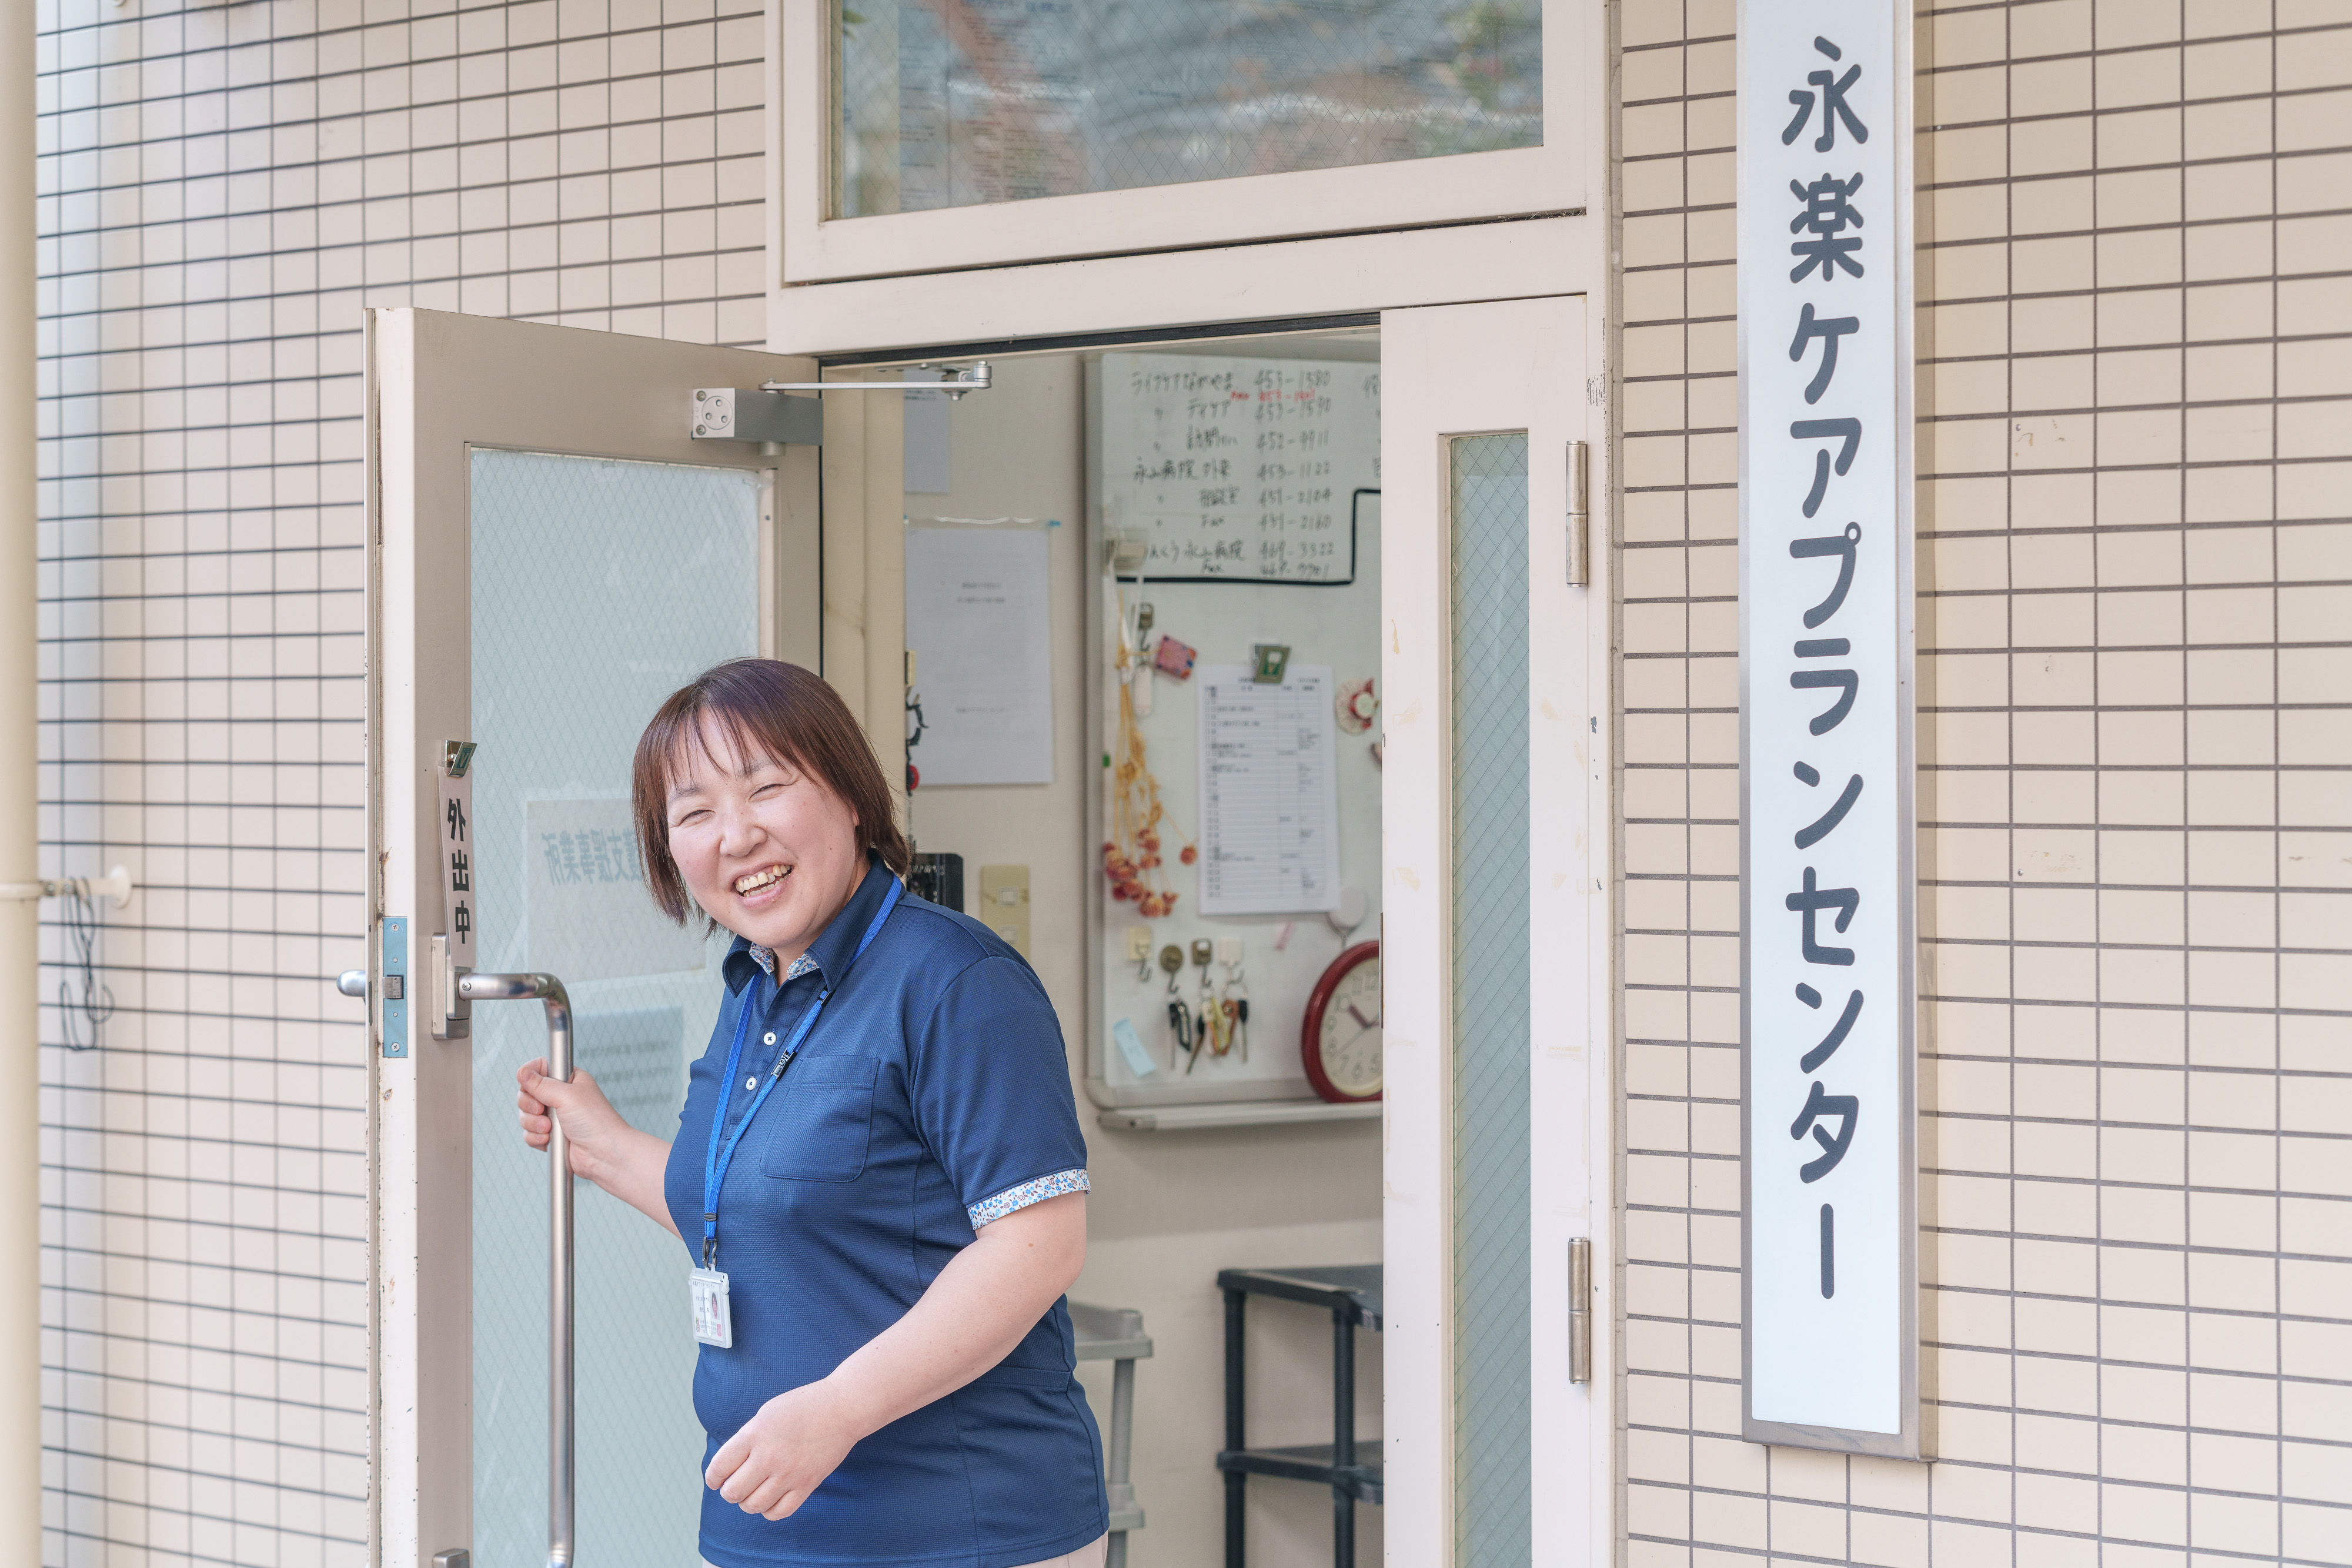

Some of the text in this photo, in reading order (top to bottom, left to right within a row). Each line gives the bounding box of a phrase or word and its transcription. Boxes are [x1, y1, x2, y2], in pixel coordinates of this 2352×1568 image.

[447, 797, 471, 945] 外出中
[1781, 35, 1869, 1299] 永楽ケアプランセンター
